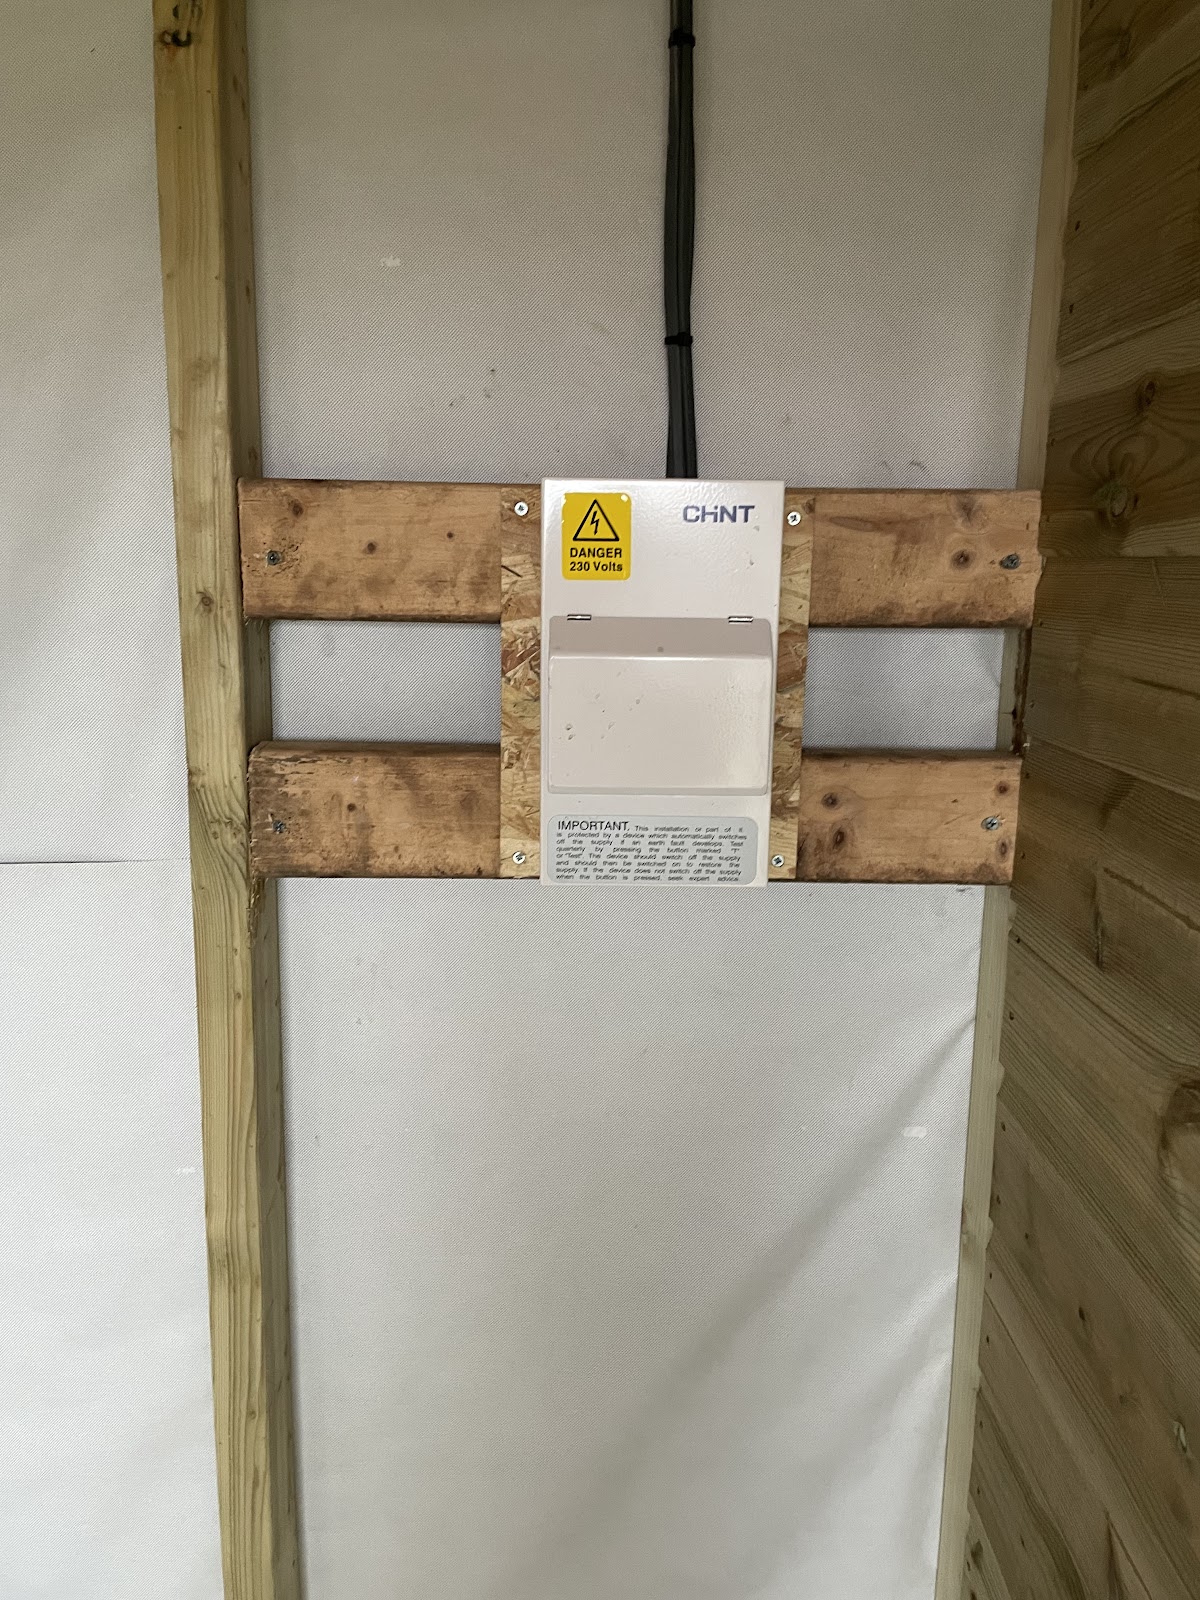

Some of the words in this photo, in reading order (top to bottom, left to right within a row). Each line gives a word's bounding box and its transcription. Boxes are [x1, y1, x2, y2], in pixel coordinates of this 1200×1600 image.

[570, 548, 622, 558] DANGER
[570, 562, 591, 572] 230
[593, 562, 622, 572] Volts
